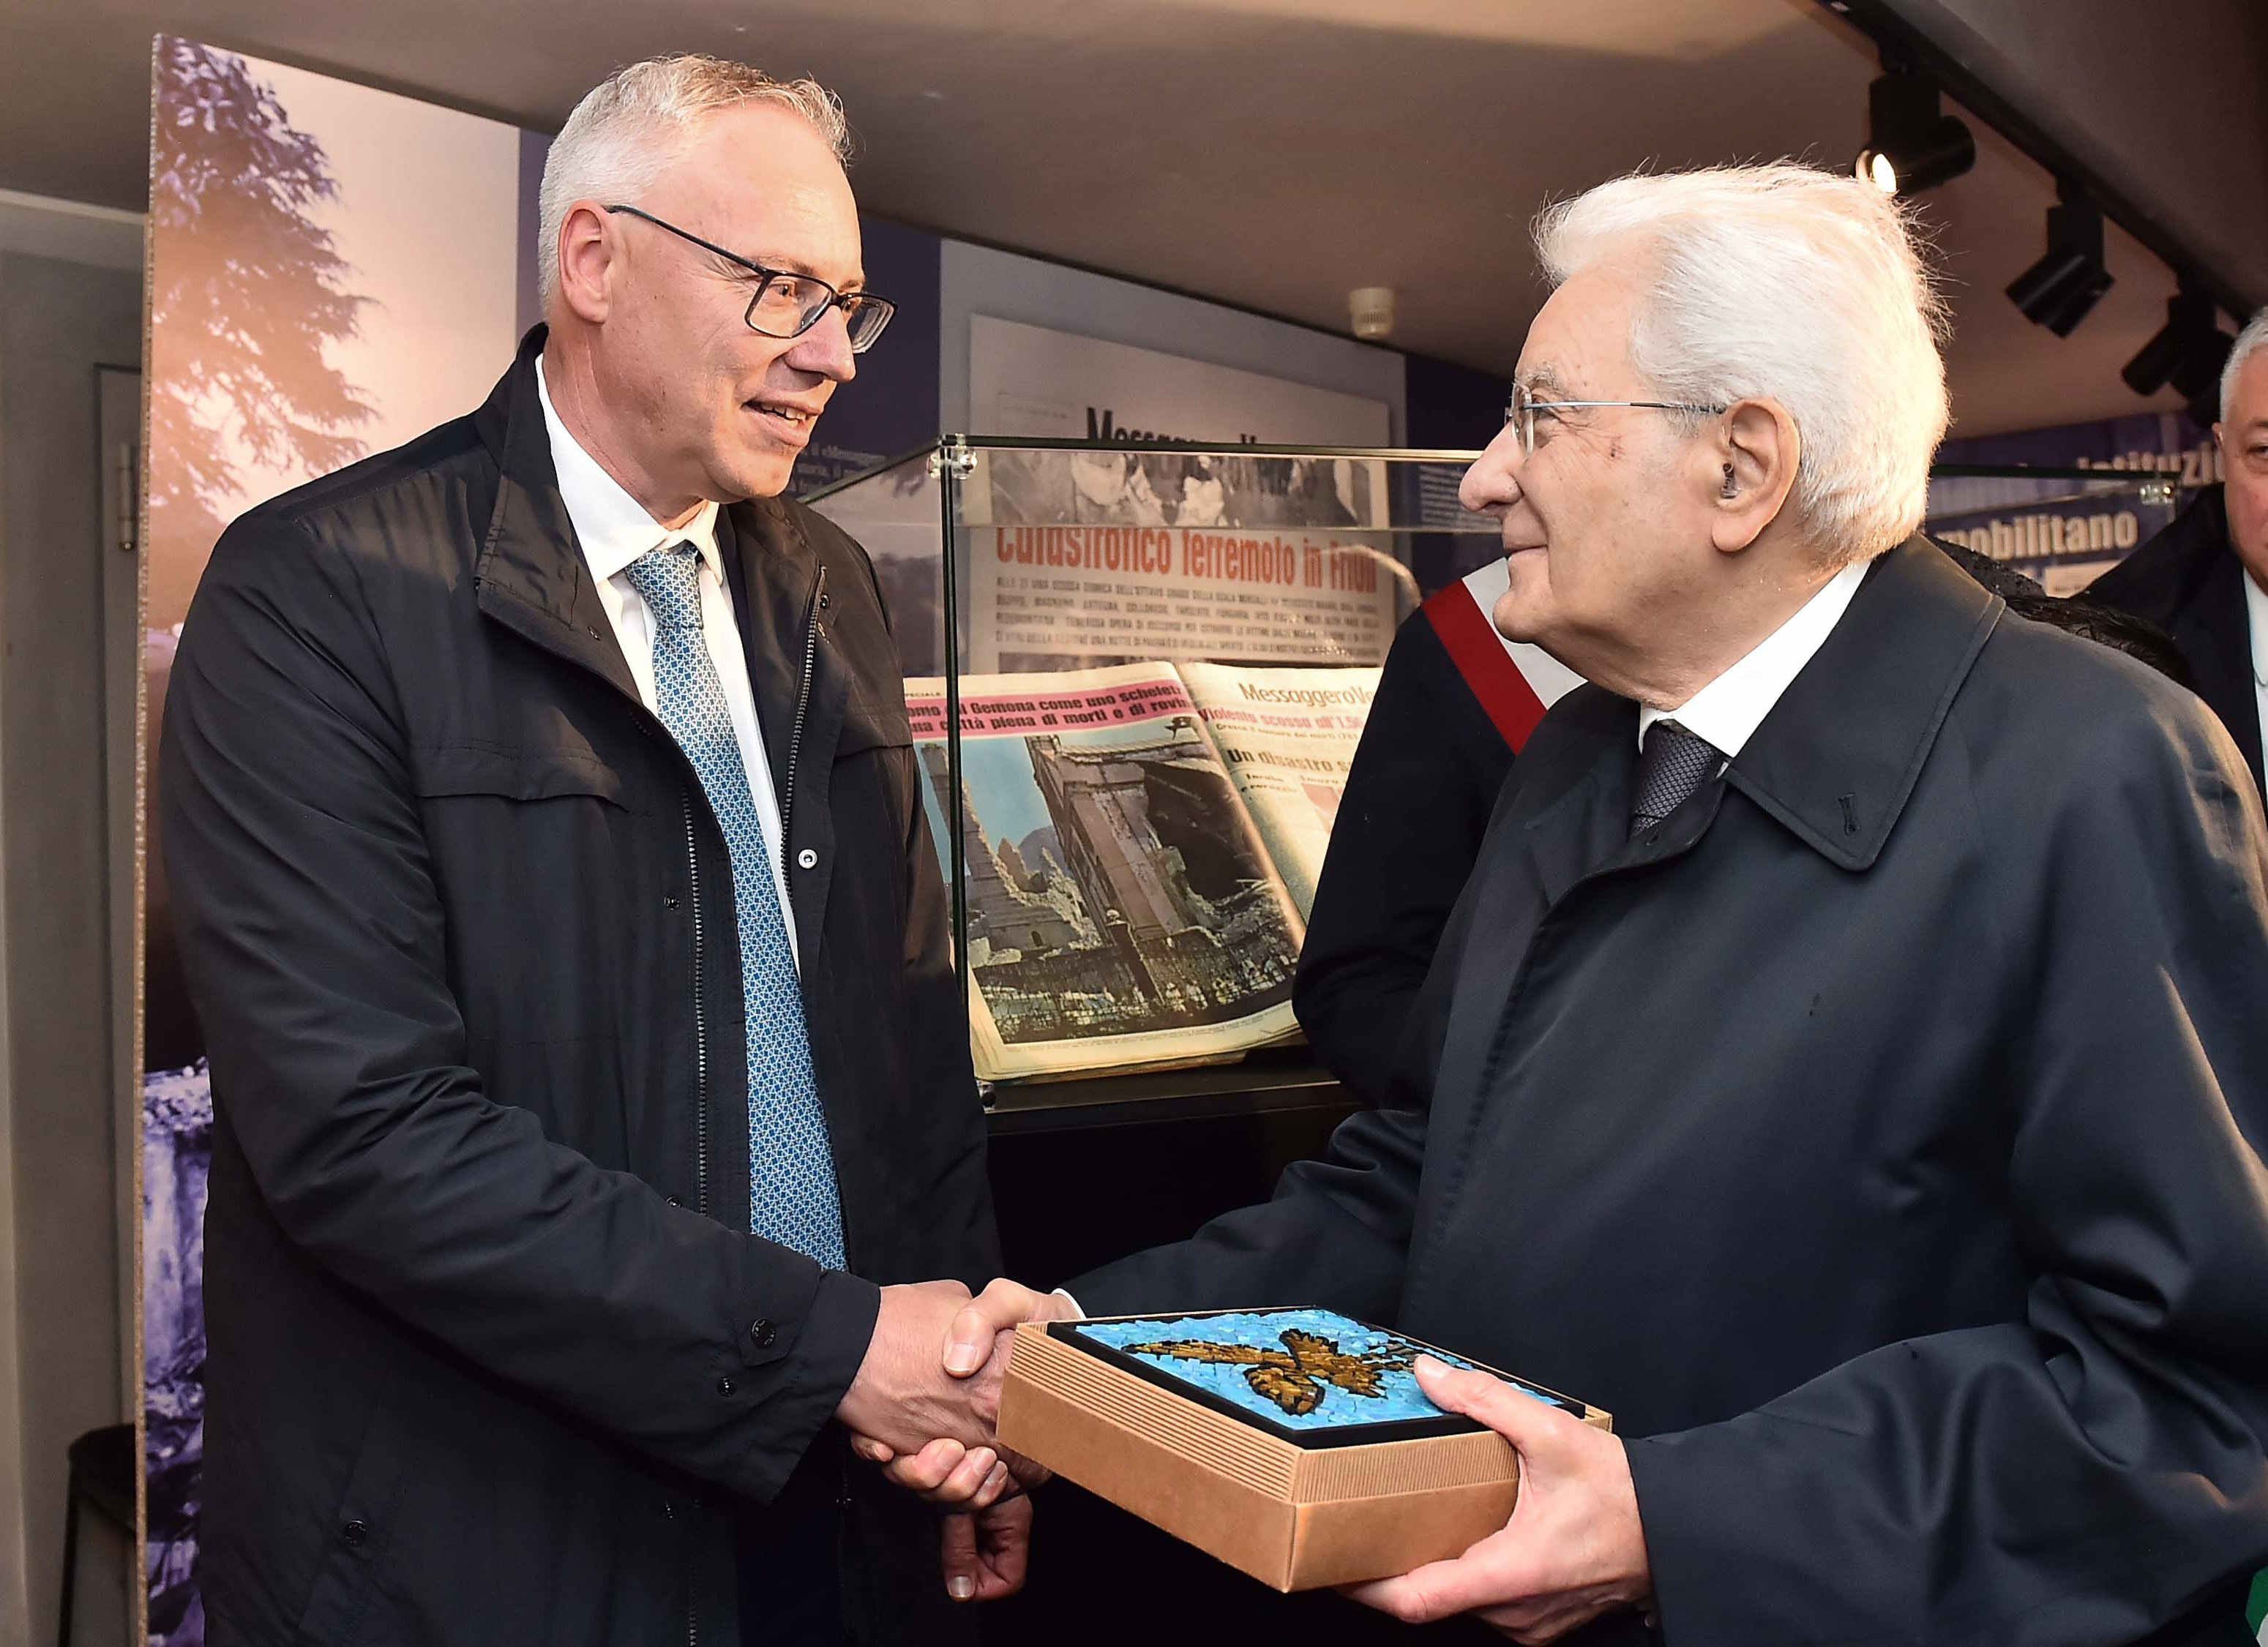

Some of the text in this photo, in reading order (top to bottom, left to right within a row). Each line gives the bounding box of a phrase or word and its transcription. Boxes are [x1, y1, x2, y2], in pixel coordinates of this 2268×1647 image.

[940, 717, 985, 731] cttà
[989, 716, 1036, 730] piena
[1041, 713, 1058, 726] di
[1063, 709, 1108, 724] morti
[1112, 708, 1124, 719] e
[1129, 702, 1146, 716] di
[970, 700, 1036, 715] Gemona
[1039, 697, 1082, 710] come
[1197, 707, 1257, 724] Violenta
[1260, 714, 1312, 728] scossa
[1227, 748, 1255, 763] Un
[1258, 750, 1333, 771] disastro
